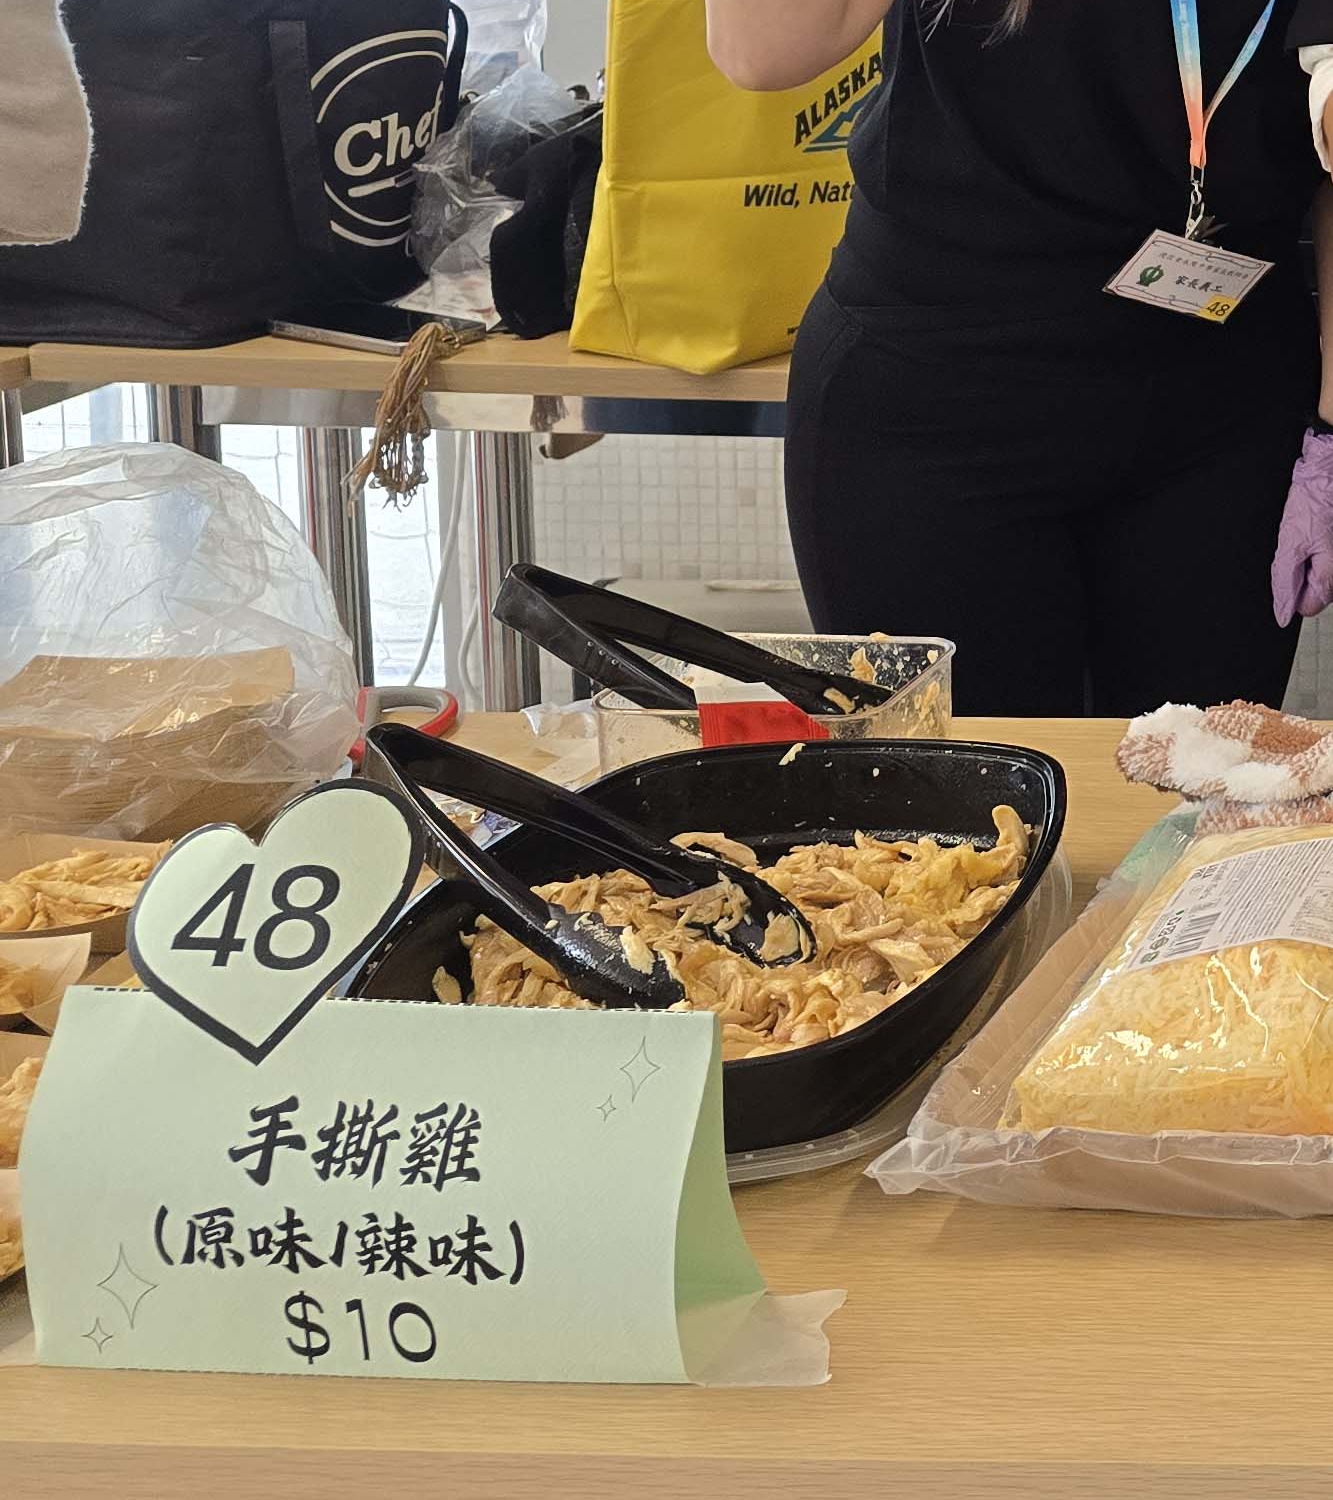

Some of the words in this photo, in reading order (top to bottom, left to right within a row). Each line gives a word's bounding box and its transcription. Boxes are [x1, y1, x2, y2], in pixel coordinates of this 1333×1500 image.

[794, 52, 883, 148] ALASKA
[744, 183, 801, 209] Wild,
[1206, 301, 1231, 316] 48
[172, 864, 341, 972] 48
[229, 1096, 484, 1192] 手撕雞
[153, 1205, 526, 1286] (原味/辣味)
[283, 1291, 438, 1365] $10
